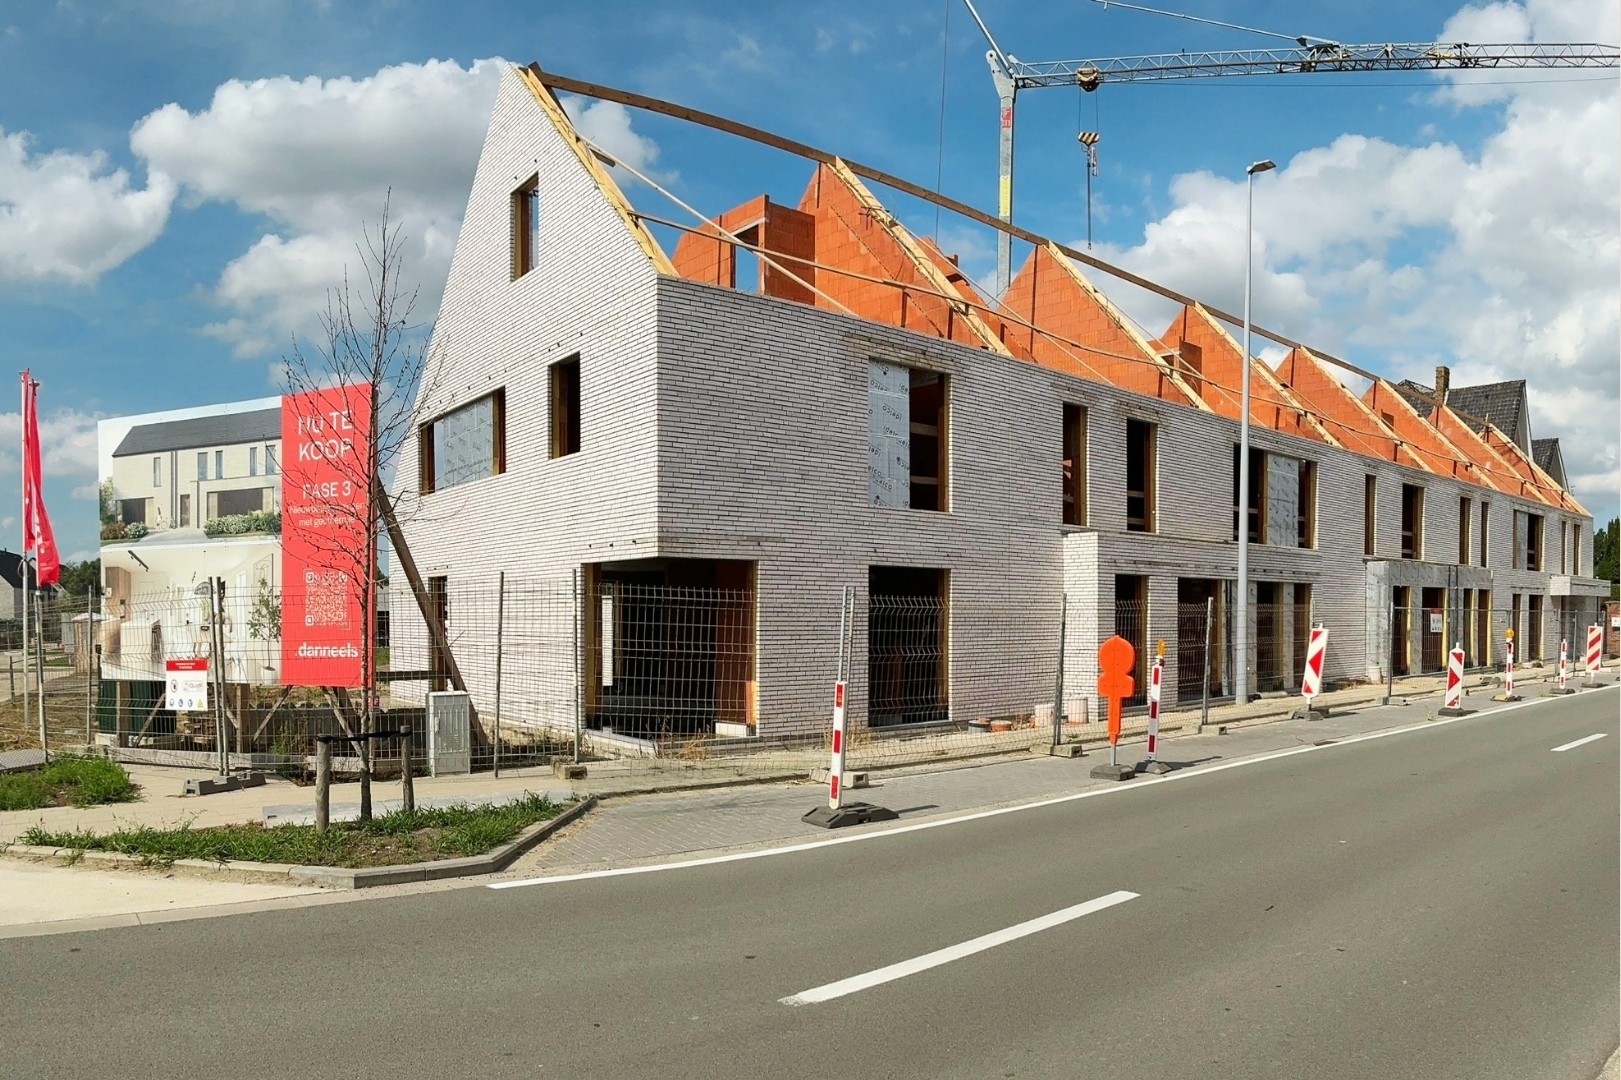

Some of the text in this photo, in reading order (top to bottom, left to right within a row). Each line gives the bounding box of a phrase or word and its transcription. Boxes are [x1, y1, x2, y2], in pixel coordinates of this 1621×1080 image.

[328, 409, 353, 430] TE
[299, 438, 351, 462] KOOP
[302, 480, 351, 499] FASE 3
[299, 517, 313, 527] met
